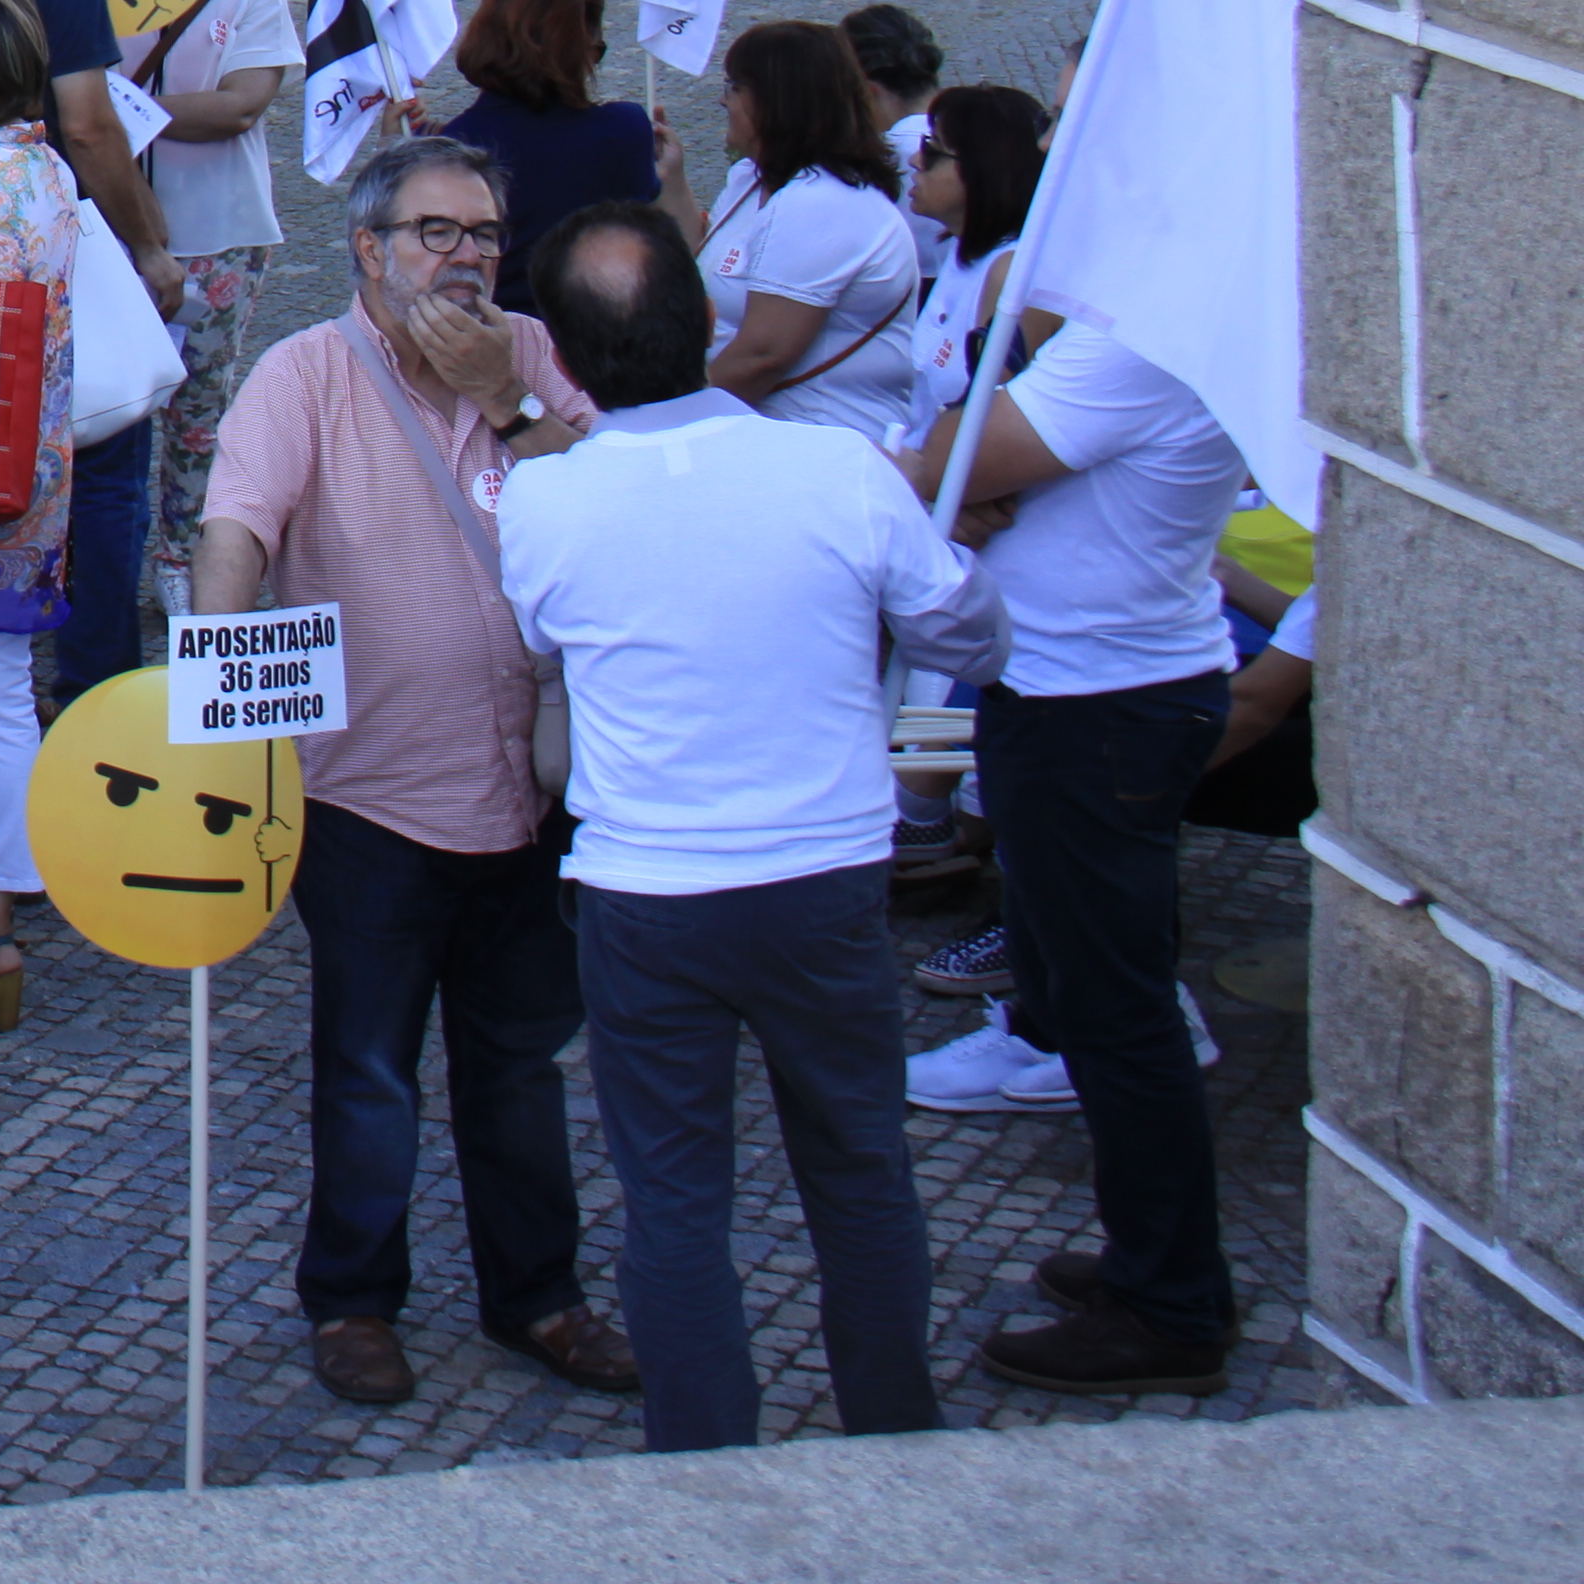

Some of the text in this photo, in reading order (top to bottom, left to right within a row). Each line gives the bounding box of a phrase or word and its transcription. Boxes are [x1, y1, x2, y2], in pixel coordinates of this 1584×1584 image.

[177, 611, 337, 658] APOSENTAÇÃO
[219, 659, 312, 693] 36 anos
[202, 691, 324, 730] de serviço
